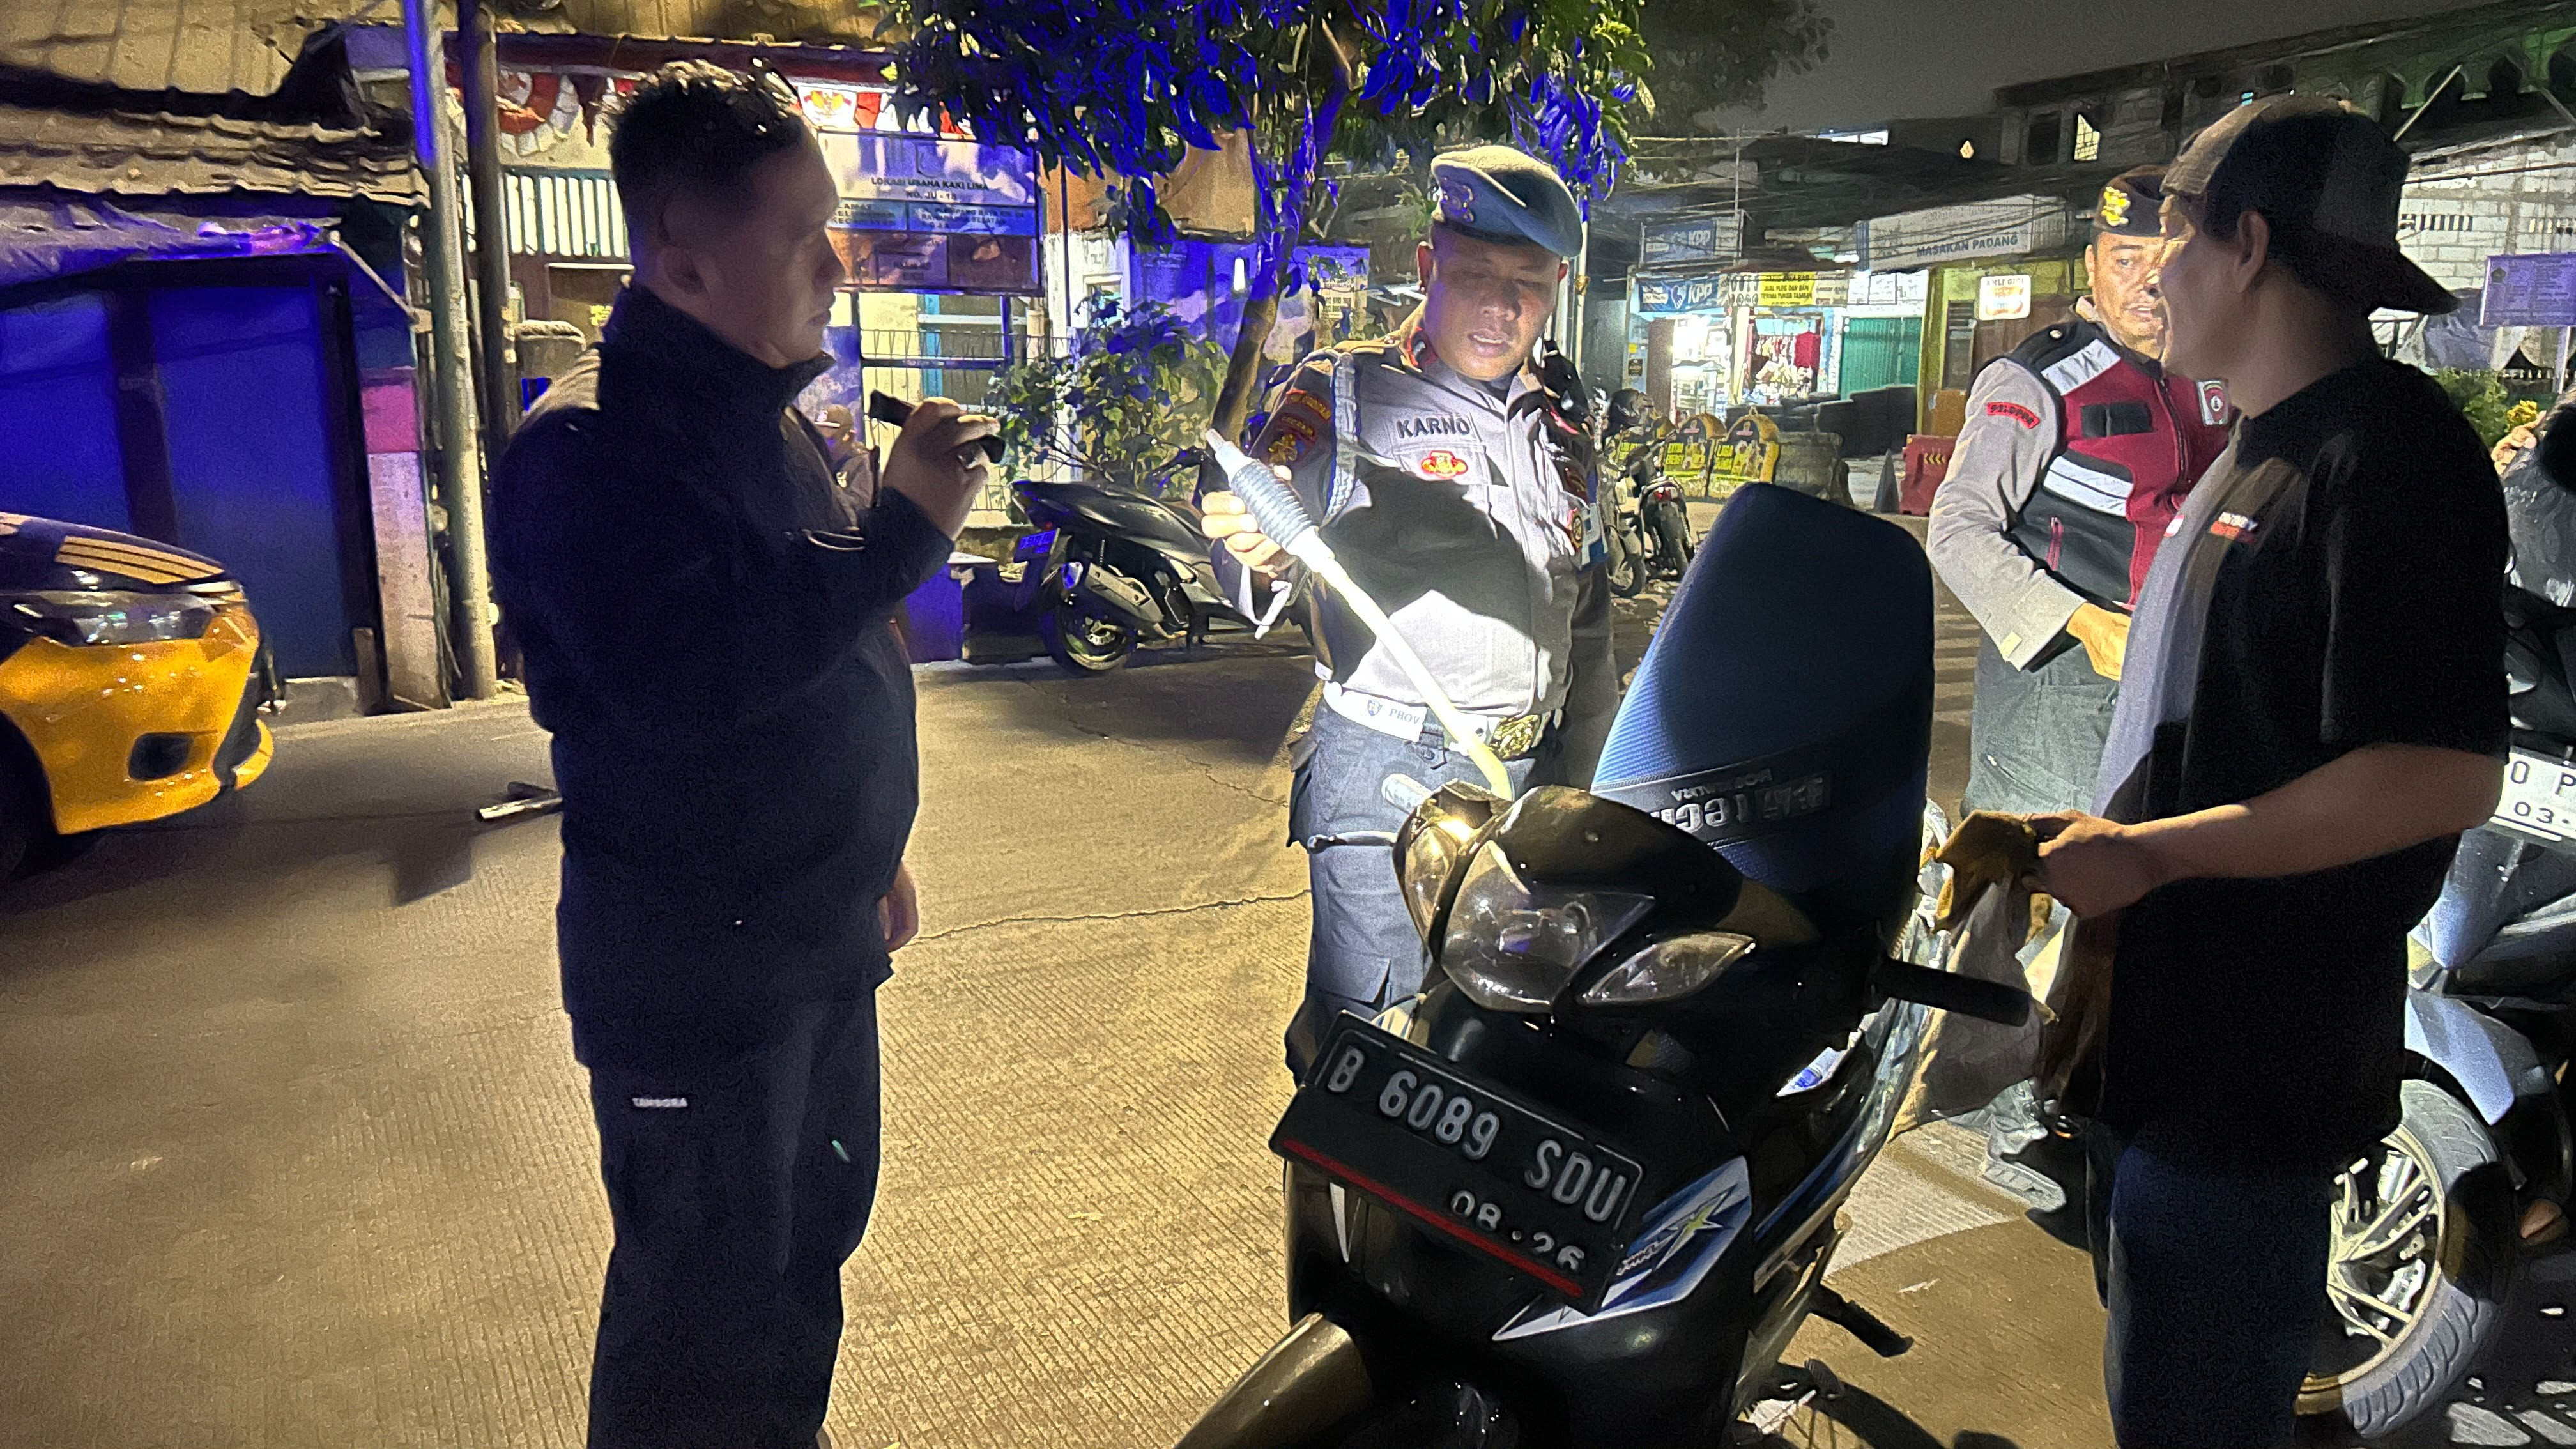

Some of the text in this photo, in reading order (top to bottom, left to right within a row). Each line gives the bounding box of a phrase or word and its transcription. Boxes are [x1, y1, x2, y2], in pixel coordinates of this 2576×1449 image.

[871, 177, 988, 190] LOKASI USAHA KAKI LIMA
[1917, 233, 2018, 256] MASAKAN PADANG
[1396, 417, 1471, 439] KARNO
[1327, 1045, 1627, 1222] B 6089 SDU
